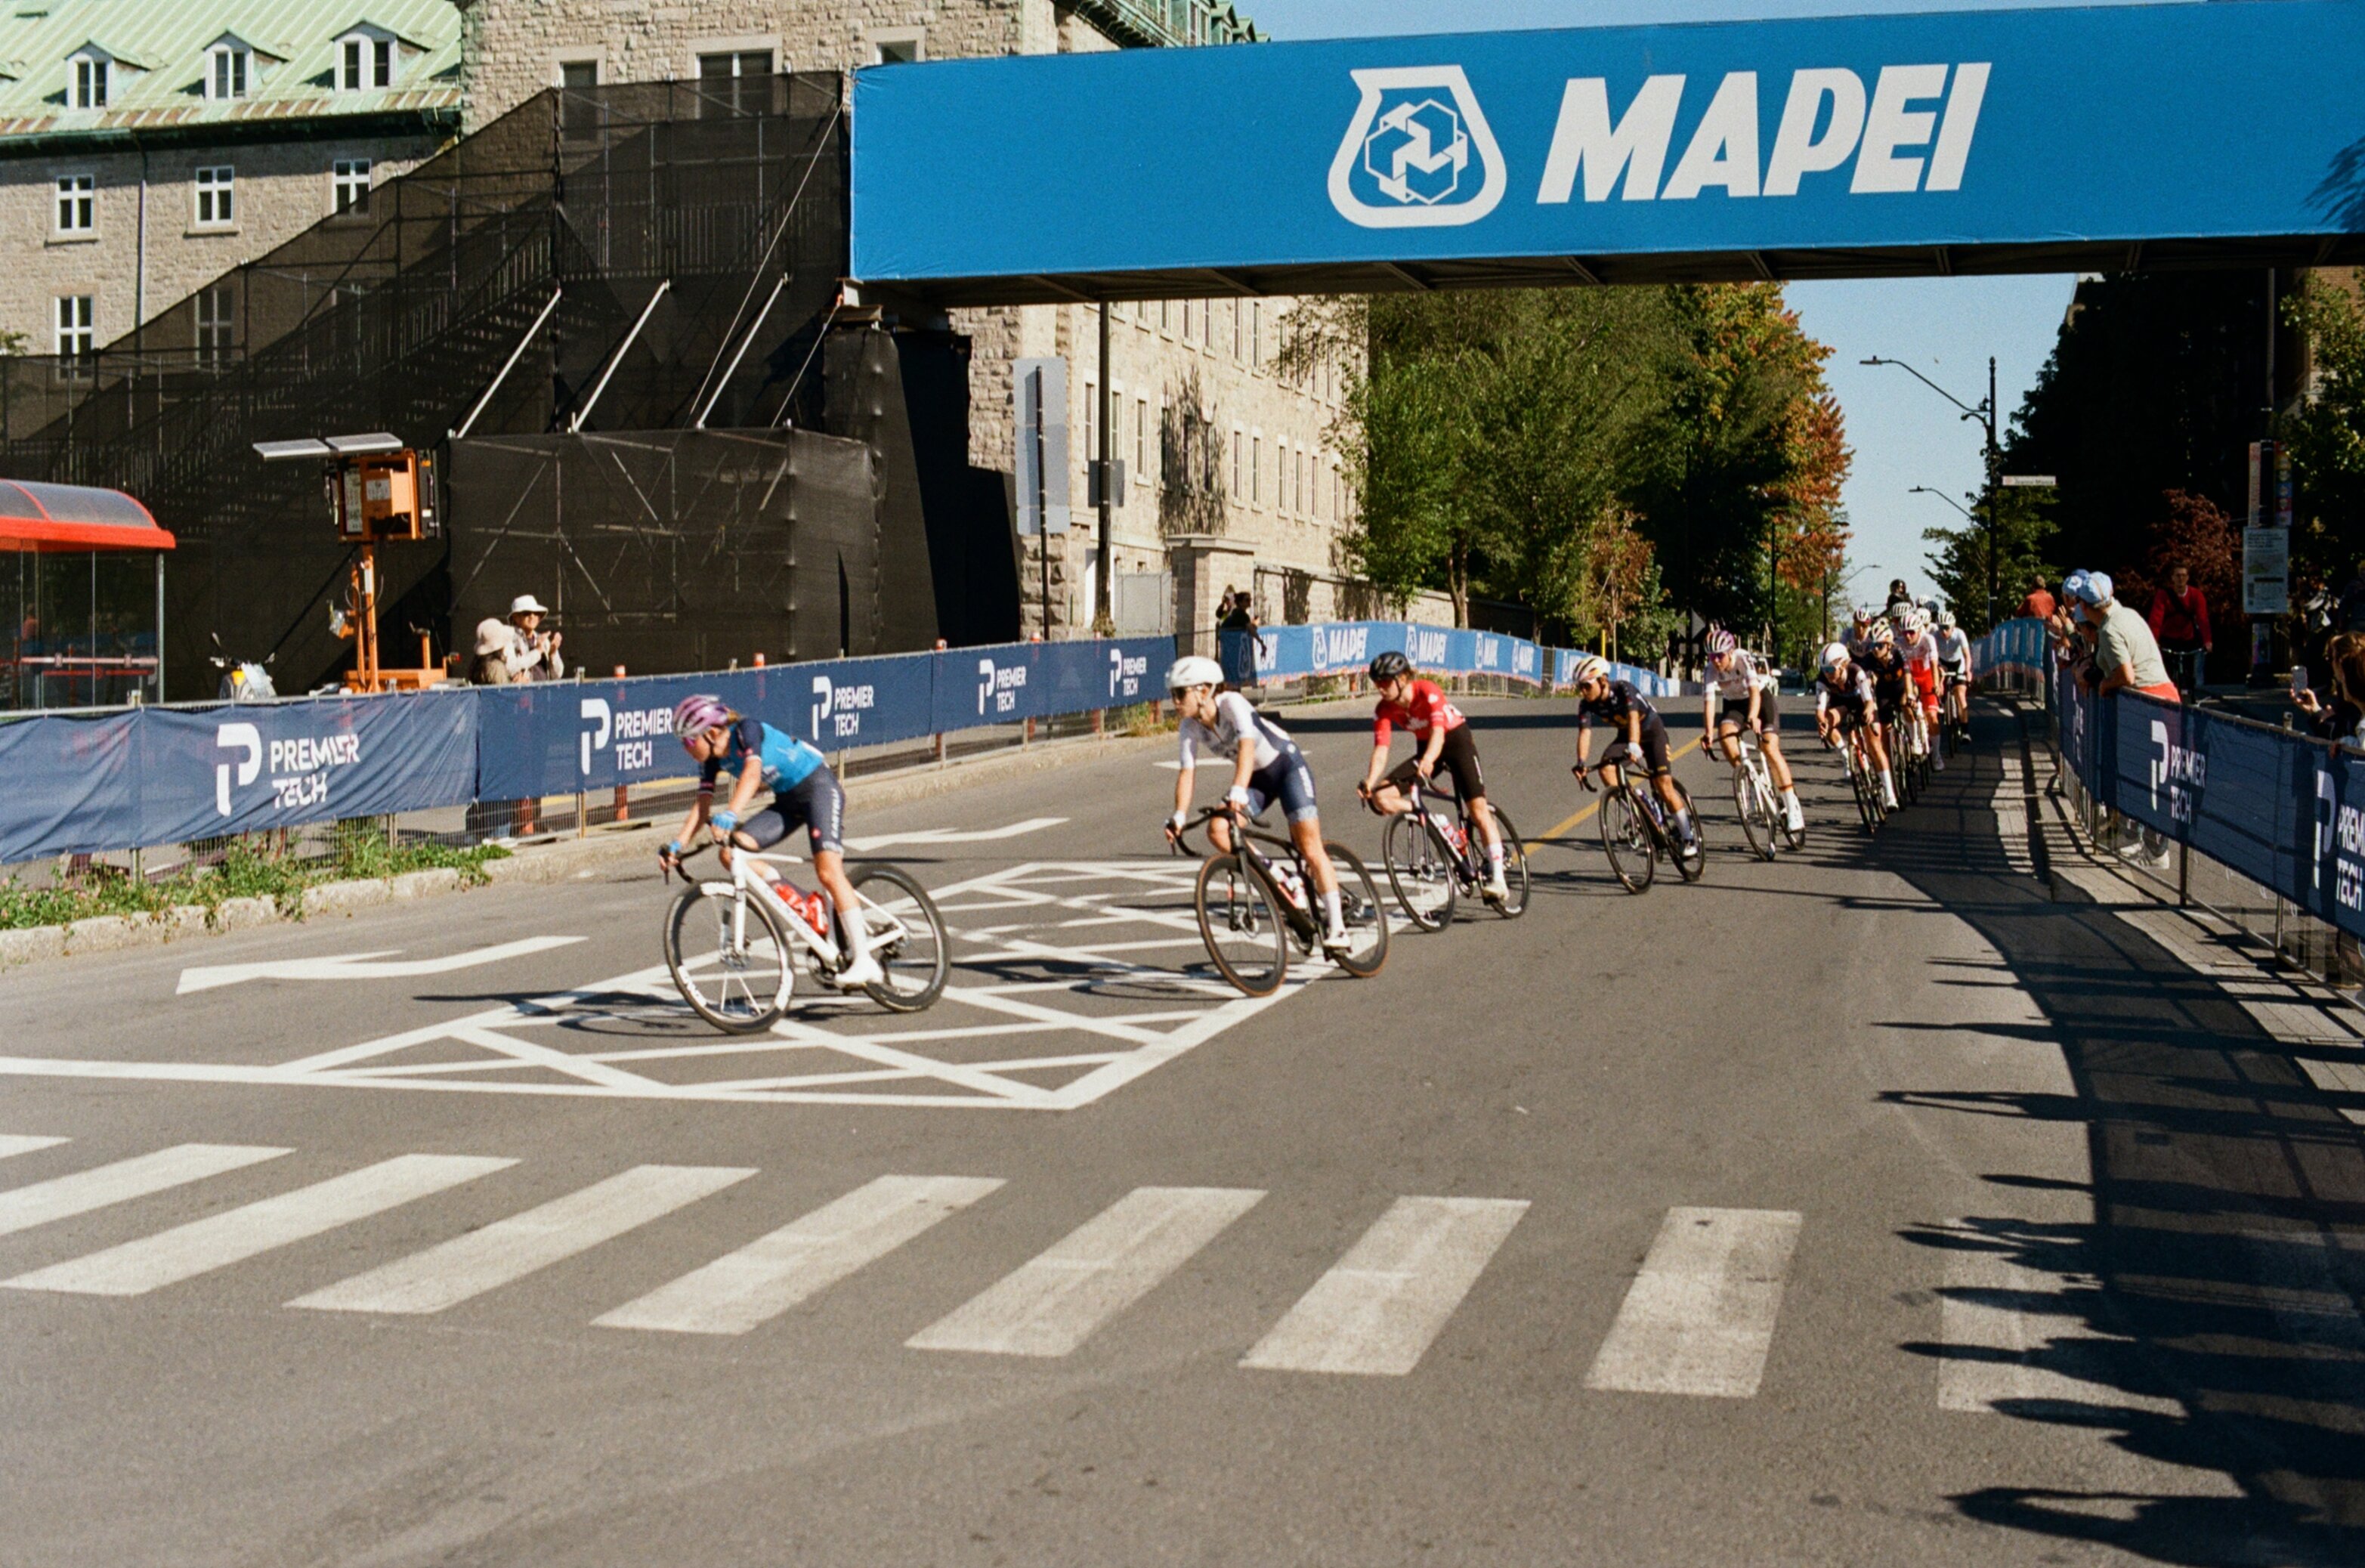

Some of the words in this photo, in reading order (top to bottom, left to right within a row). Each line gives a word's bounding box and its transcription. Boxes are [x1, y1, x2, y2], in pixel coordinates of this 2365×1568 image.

[1536, 62, 1992, 204] MAPEI
[1328, 627, 1368, 663] MAPEI
[1417, 630, 1448, 663] MAPEI
[997, 666, 1026, 689] PREMIER
[1123, 657, 1147, 676] PREMIER
[834, 685, 874, 710] PREMIER
[996, 690, 1015, 712] TECH
[1123, 677, 1138, 696] TECH
[615, 707, 673, 739] PREMIER
[834, 712, 859, 737] TECH
[271, 733, 360, 773] PREMIER
[615, 741, 652, 771] TECH
[2170, 745, 2206, 788] PREMIER
[271, 772, 327, 809] TECH
[2170, 785, 2191, 825] TECH
[2336, 858, 2362, 911] TECH
